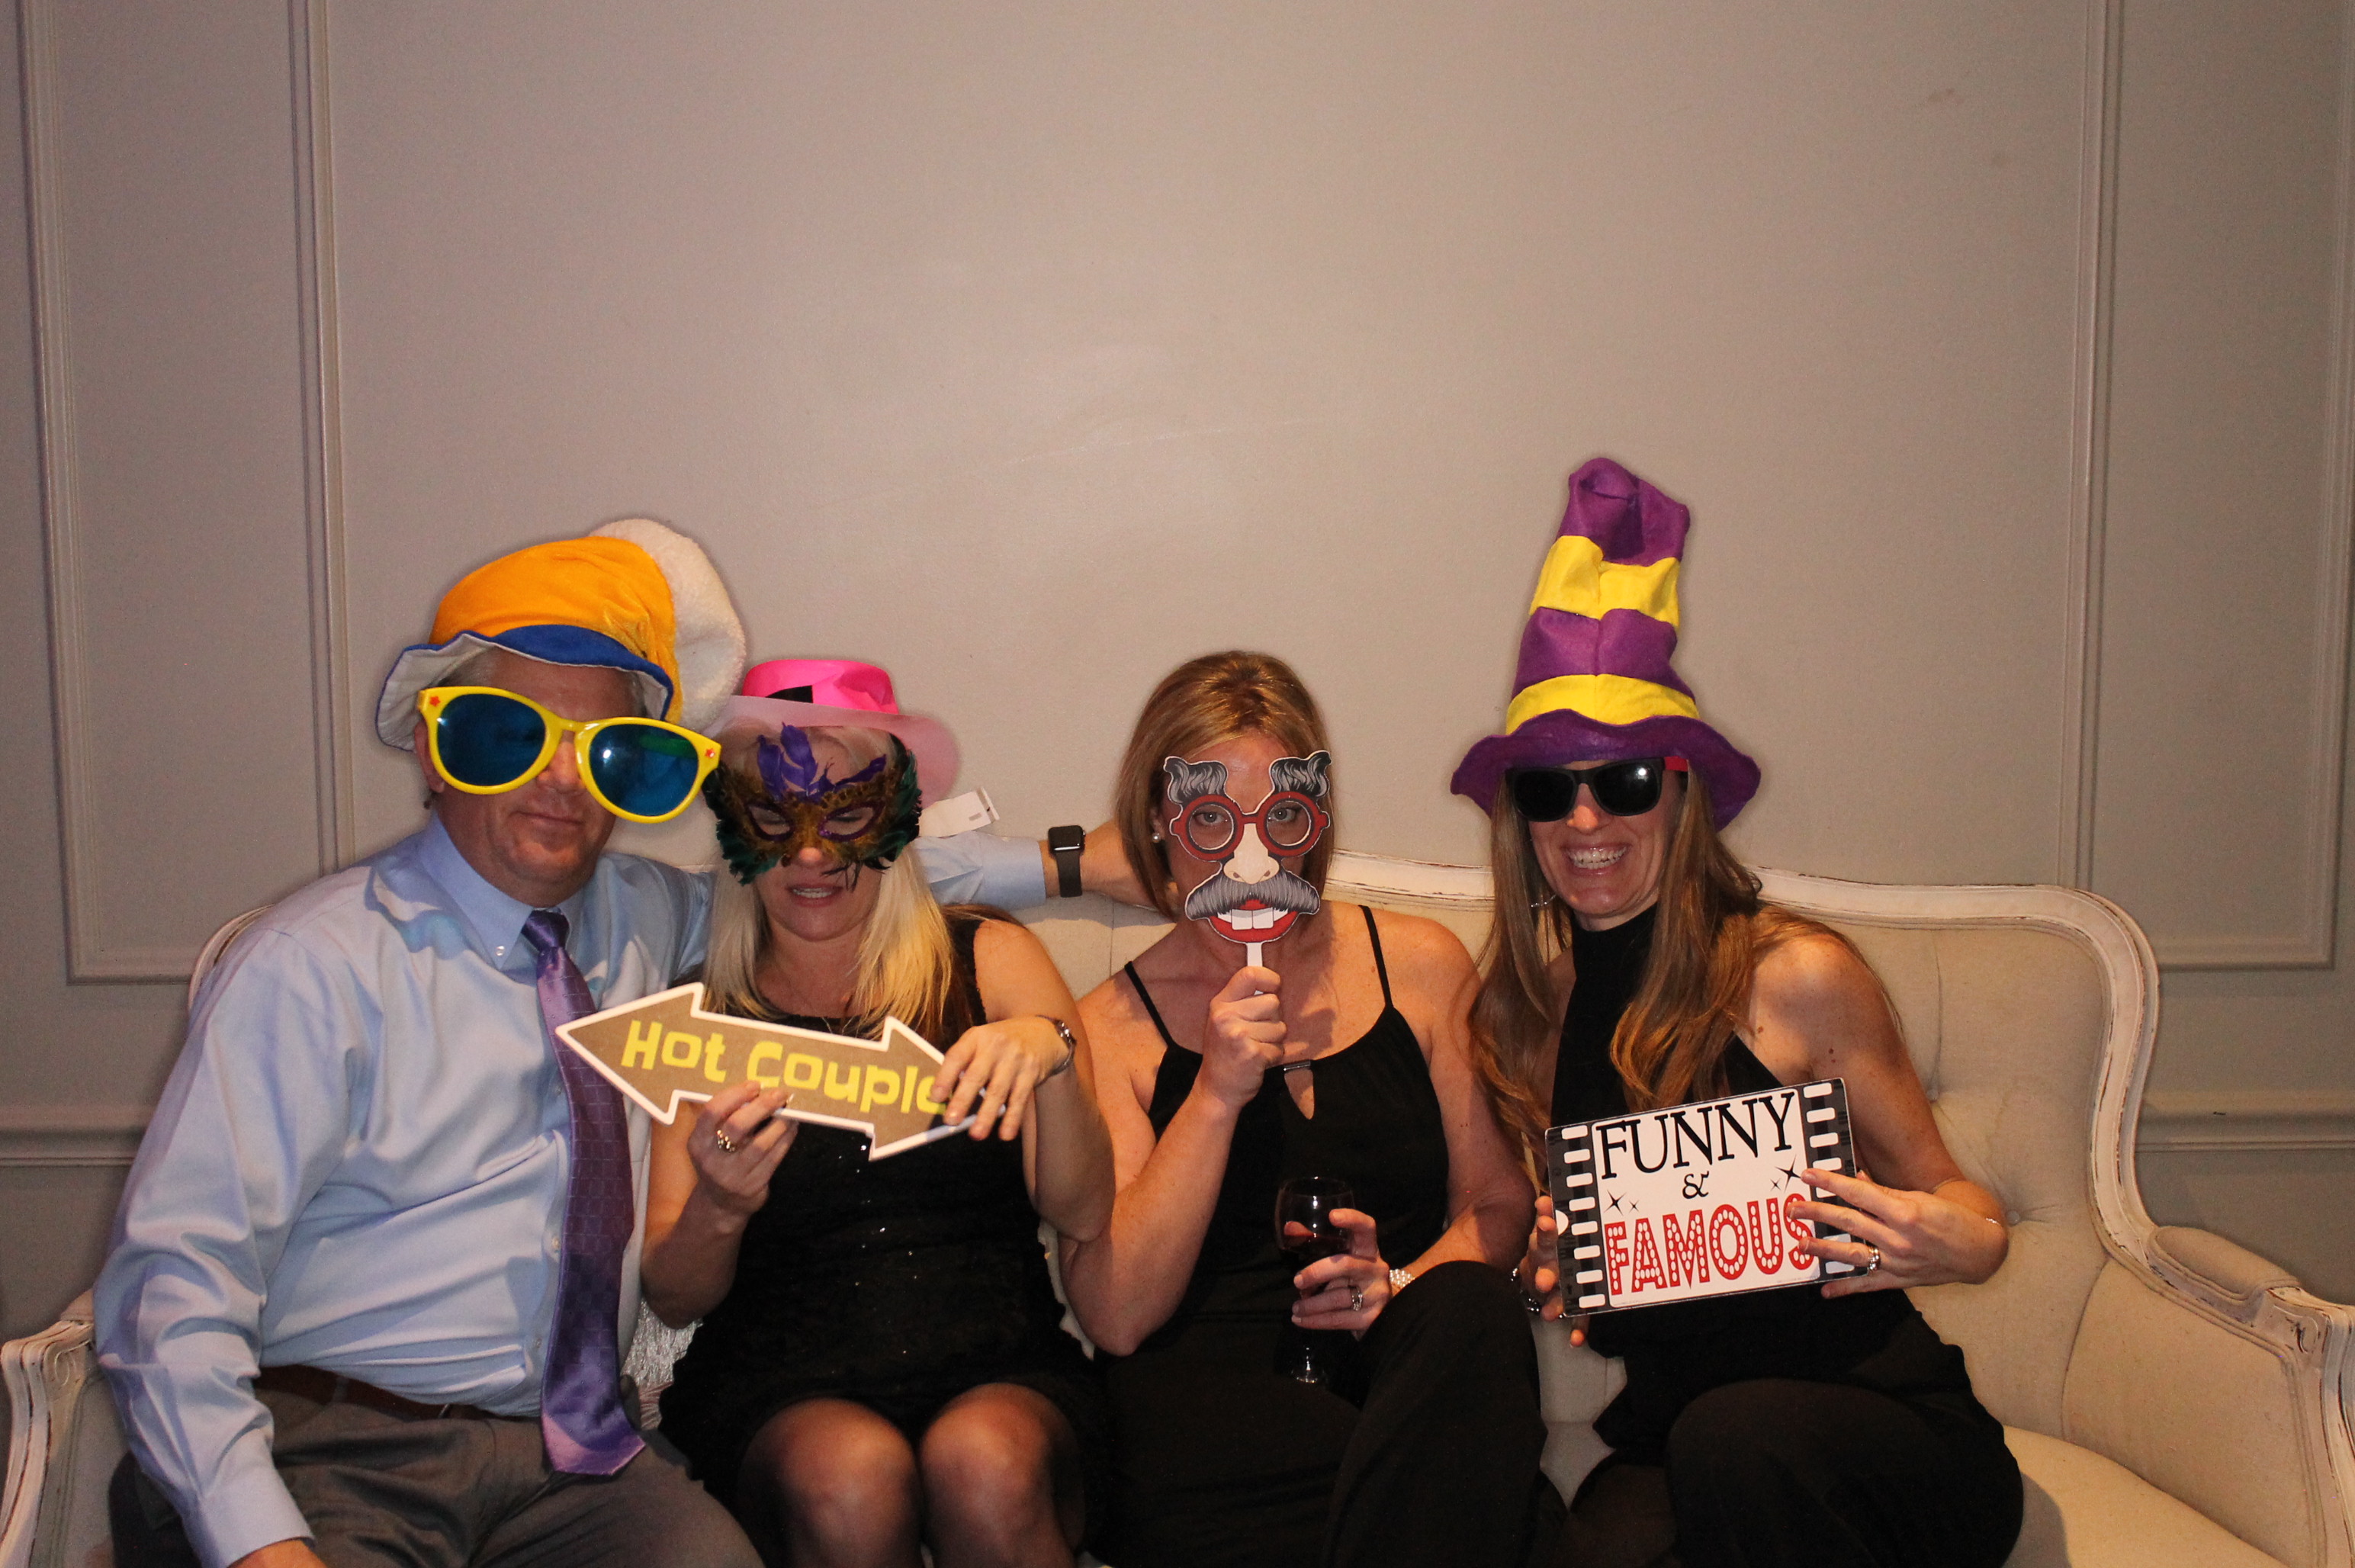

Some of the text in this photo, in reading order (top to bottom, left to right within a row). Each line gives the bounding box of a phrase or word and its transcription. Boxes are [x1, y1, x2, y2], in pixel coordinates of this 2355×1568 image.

[620, 1020, 727, 1083] Hot
[1595, 1091, 1795, 1179] FUNNY
[1682, 1171, 1709, 1200] &
[1604, 1193, 1814, 1296] FAMOUS
